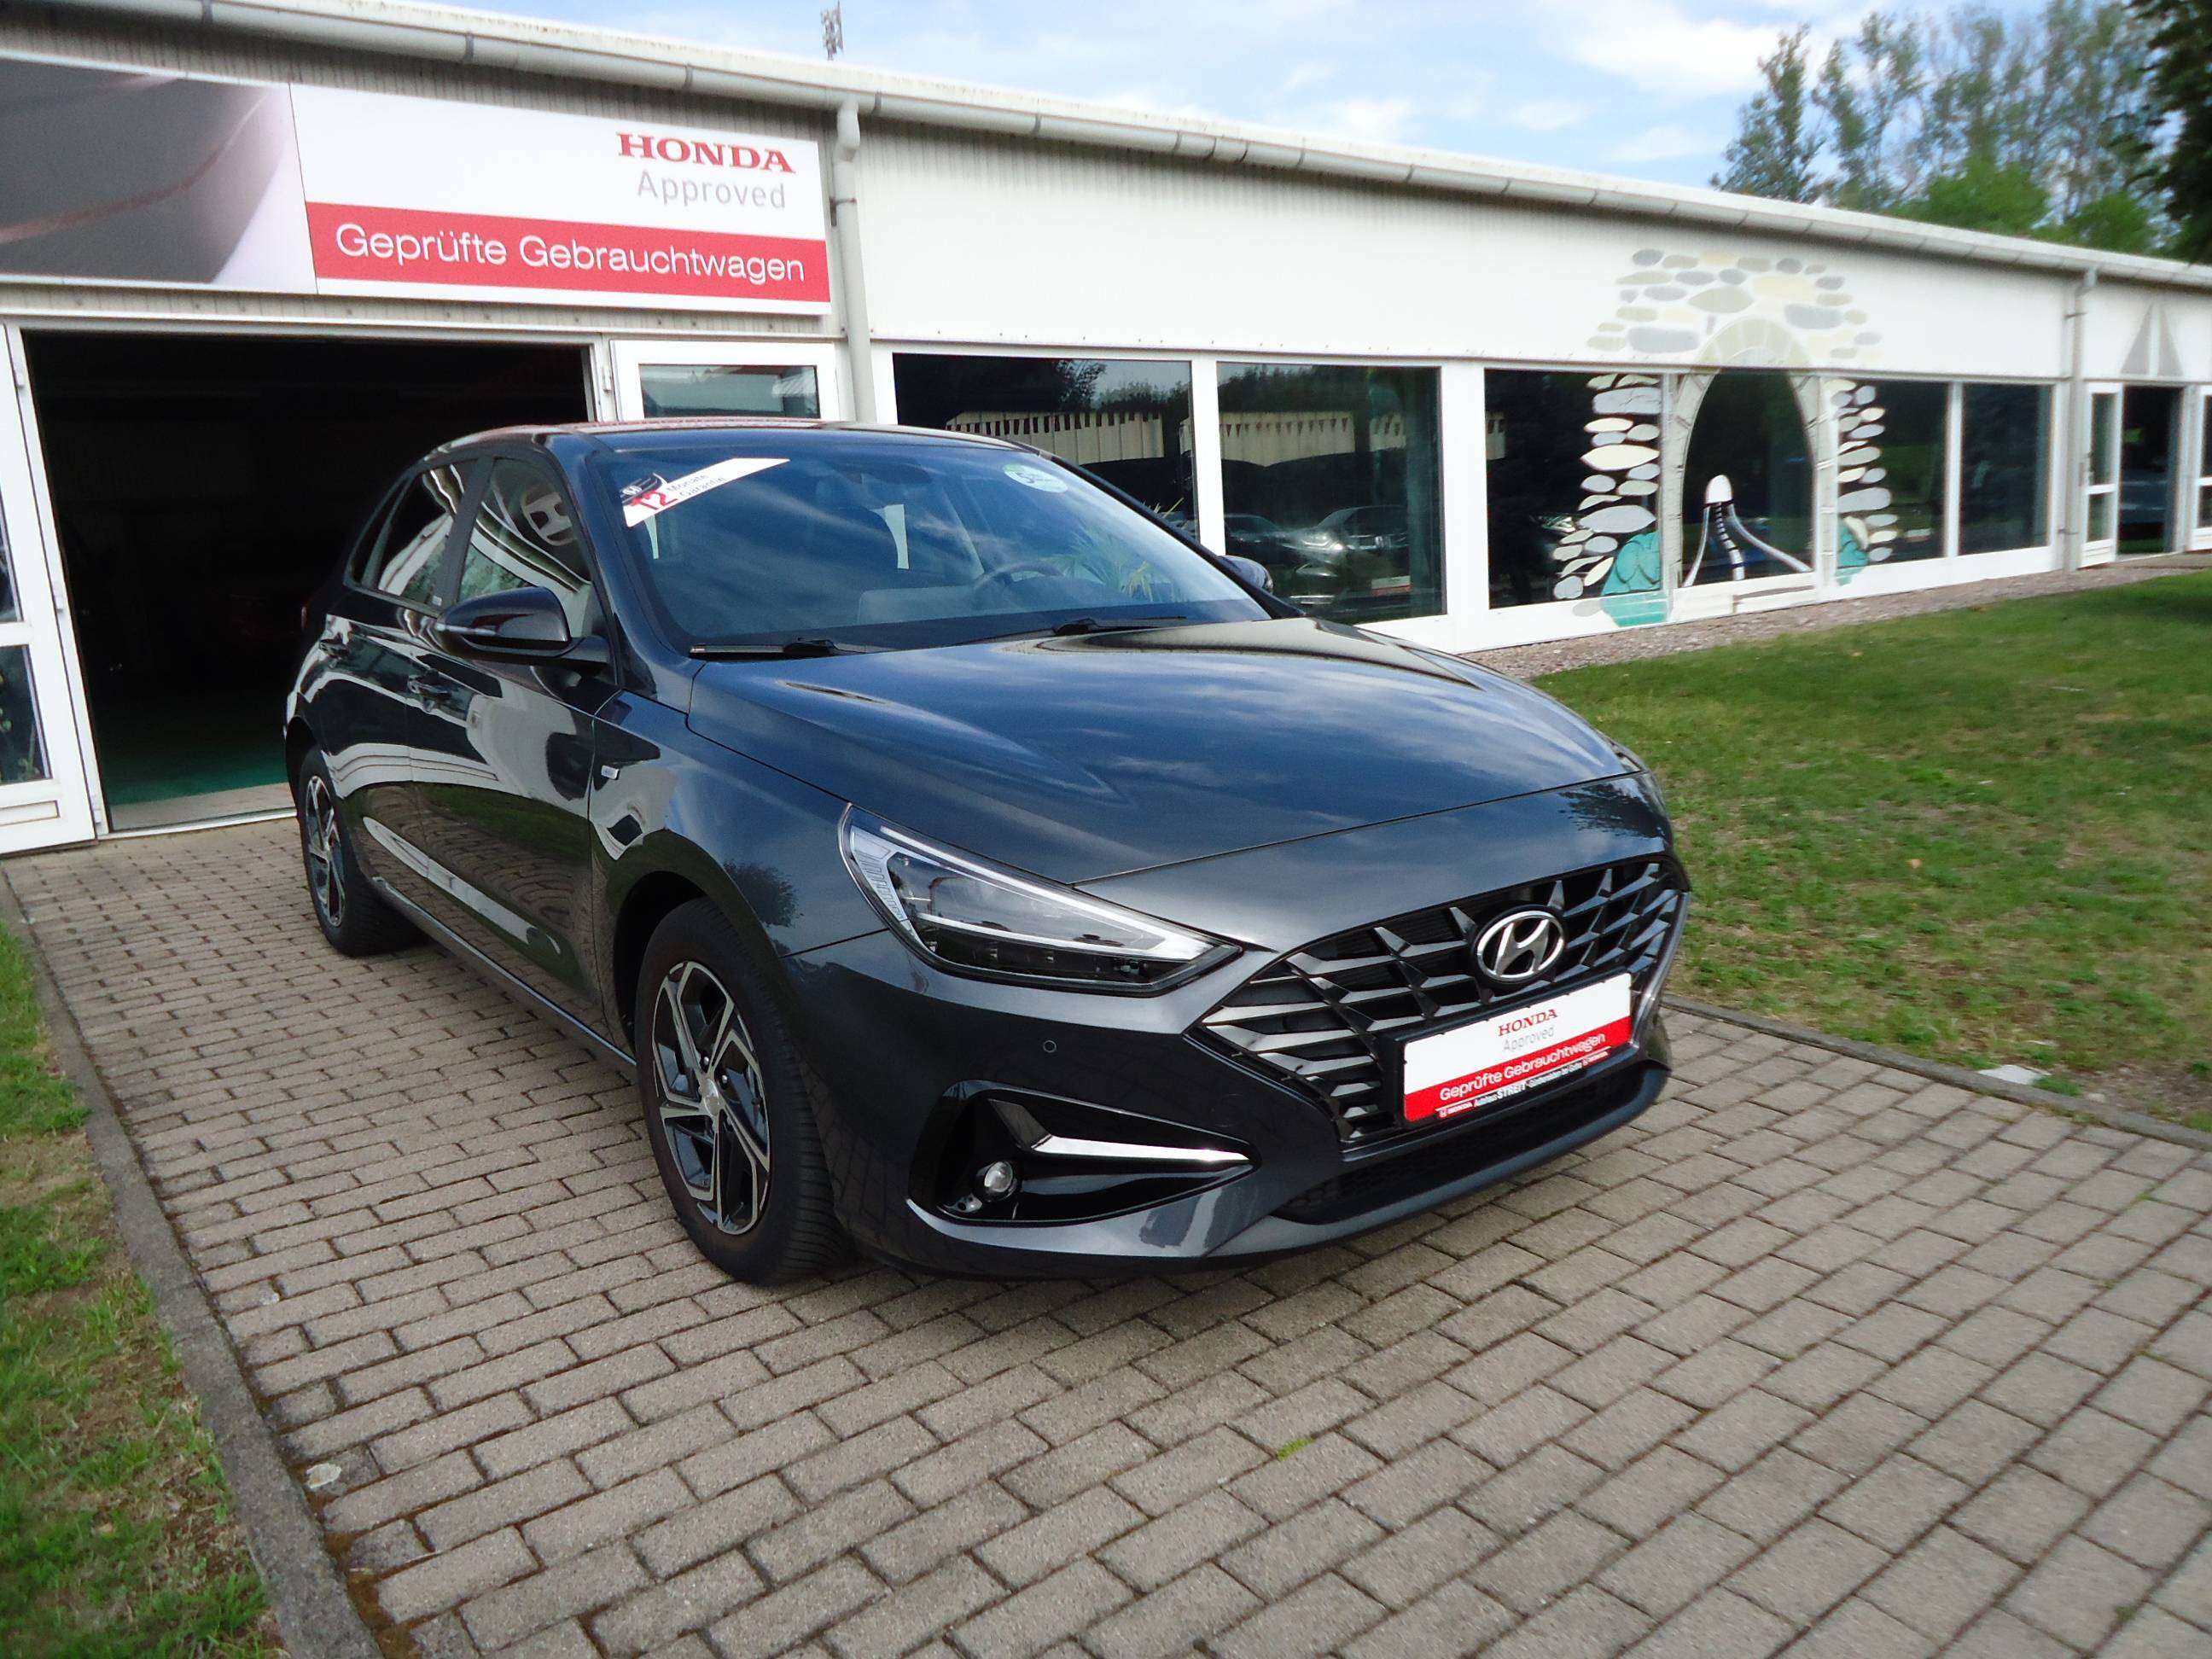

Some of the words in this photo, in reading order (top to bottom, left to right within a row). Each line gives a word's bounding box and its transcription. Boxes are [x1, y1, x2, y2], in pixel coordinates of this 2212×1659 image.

[617, 131, 795, 174] HONDA
[637, 171, 787, 209] Approved
[335, 223, 507, 267] Geprüfte
[518, 235, 805, 286] Gebrauchtwagen
[1497, 1008, 1558, 1037] HONDA
[1502, 1027, 1555, 1053] Approved
[1440, 1071, 1503, 1101] Geprüfte
[1504, 1032, 1606, 1080] Gebrauchtwagen
